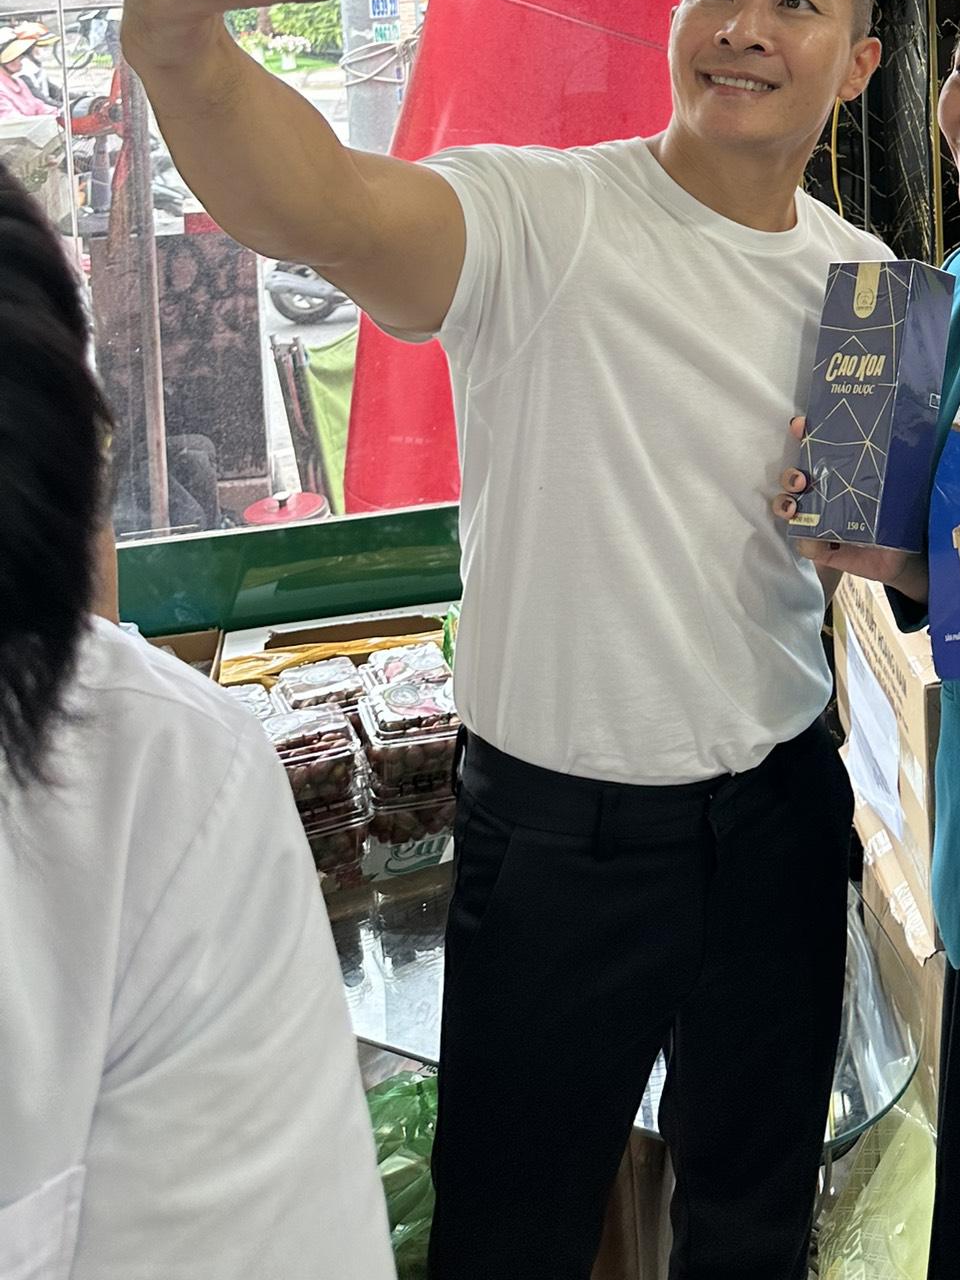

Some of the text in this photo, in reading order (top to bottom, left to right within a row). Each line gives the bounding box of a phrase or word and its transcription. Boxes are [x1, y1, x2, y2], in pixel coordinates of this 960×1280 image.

[825, 352, 887, 382] CAO XOA
[847, 521, 866, 532] 150 G
